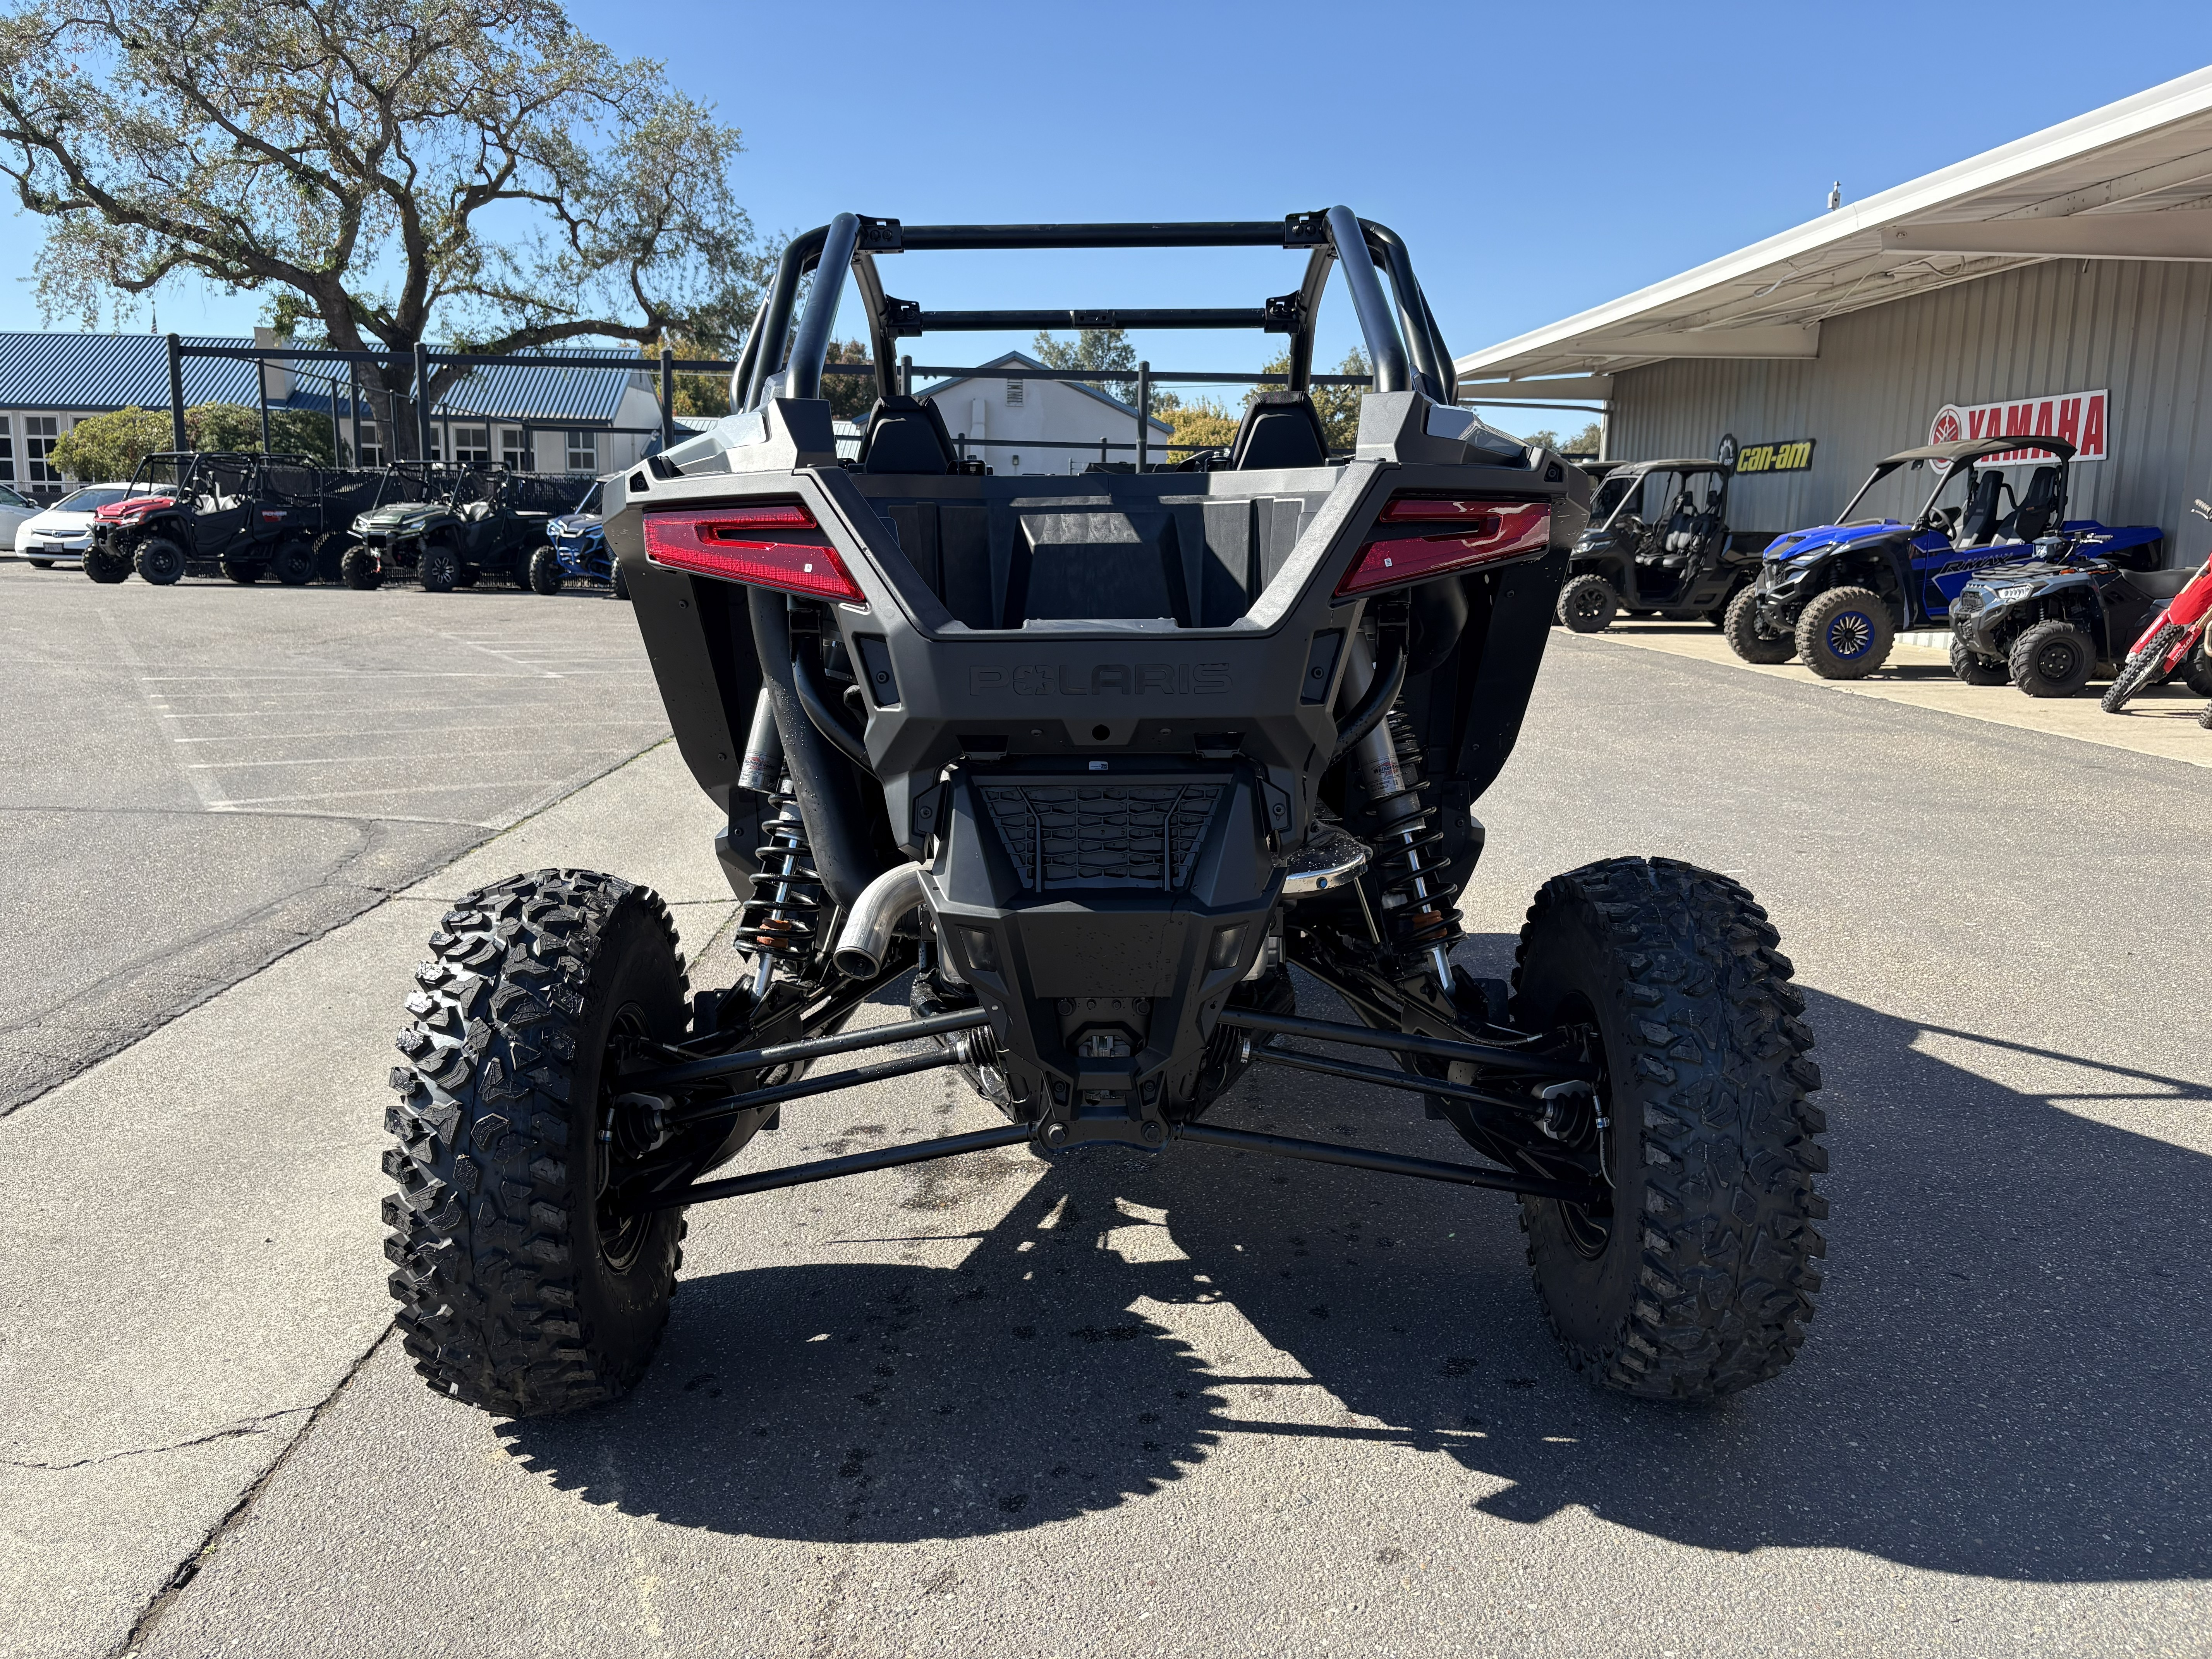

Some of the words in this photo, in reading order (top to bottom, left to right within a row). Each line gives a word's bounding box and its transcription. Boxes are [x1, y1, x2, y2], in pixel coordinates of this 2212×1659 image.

[1969, 395, 2104, 462] YAMAHA
[1736, 442, 1810, 472] can-am
[1939, 554, 2013, 574] RMAX
[2173, 634, 2194, 662] DUNLOP
[969, 663, 1233, 696] POLARIS
[1373, 765, 1392, 774] Walker
